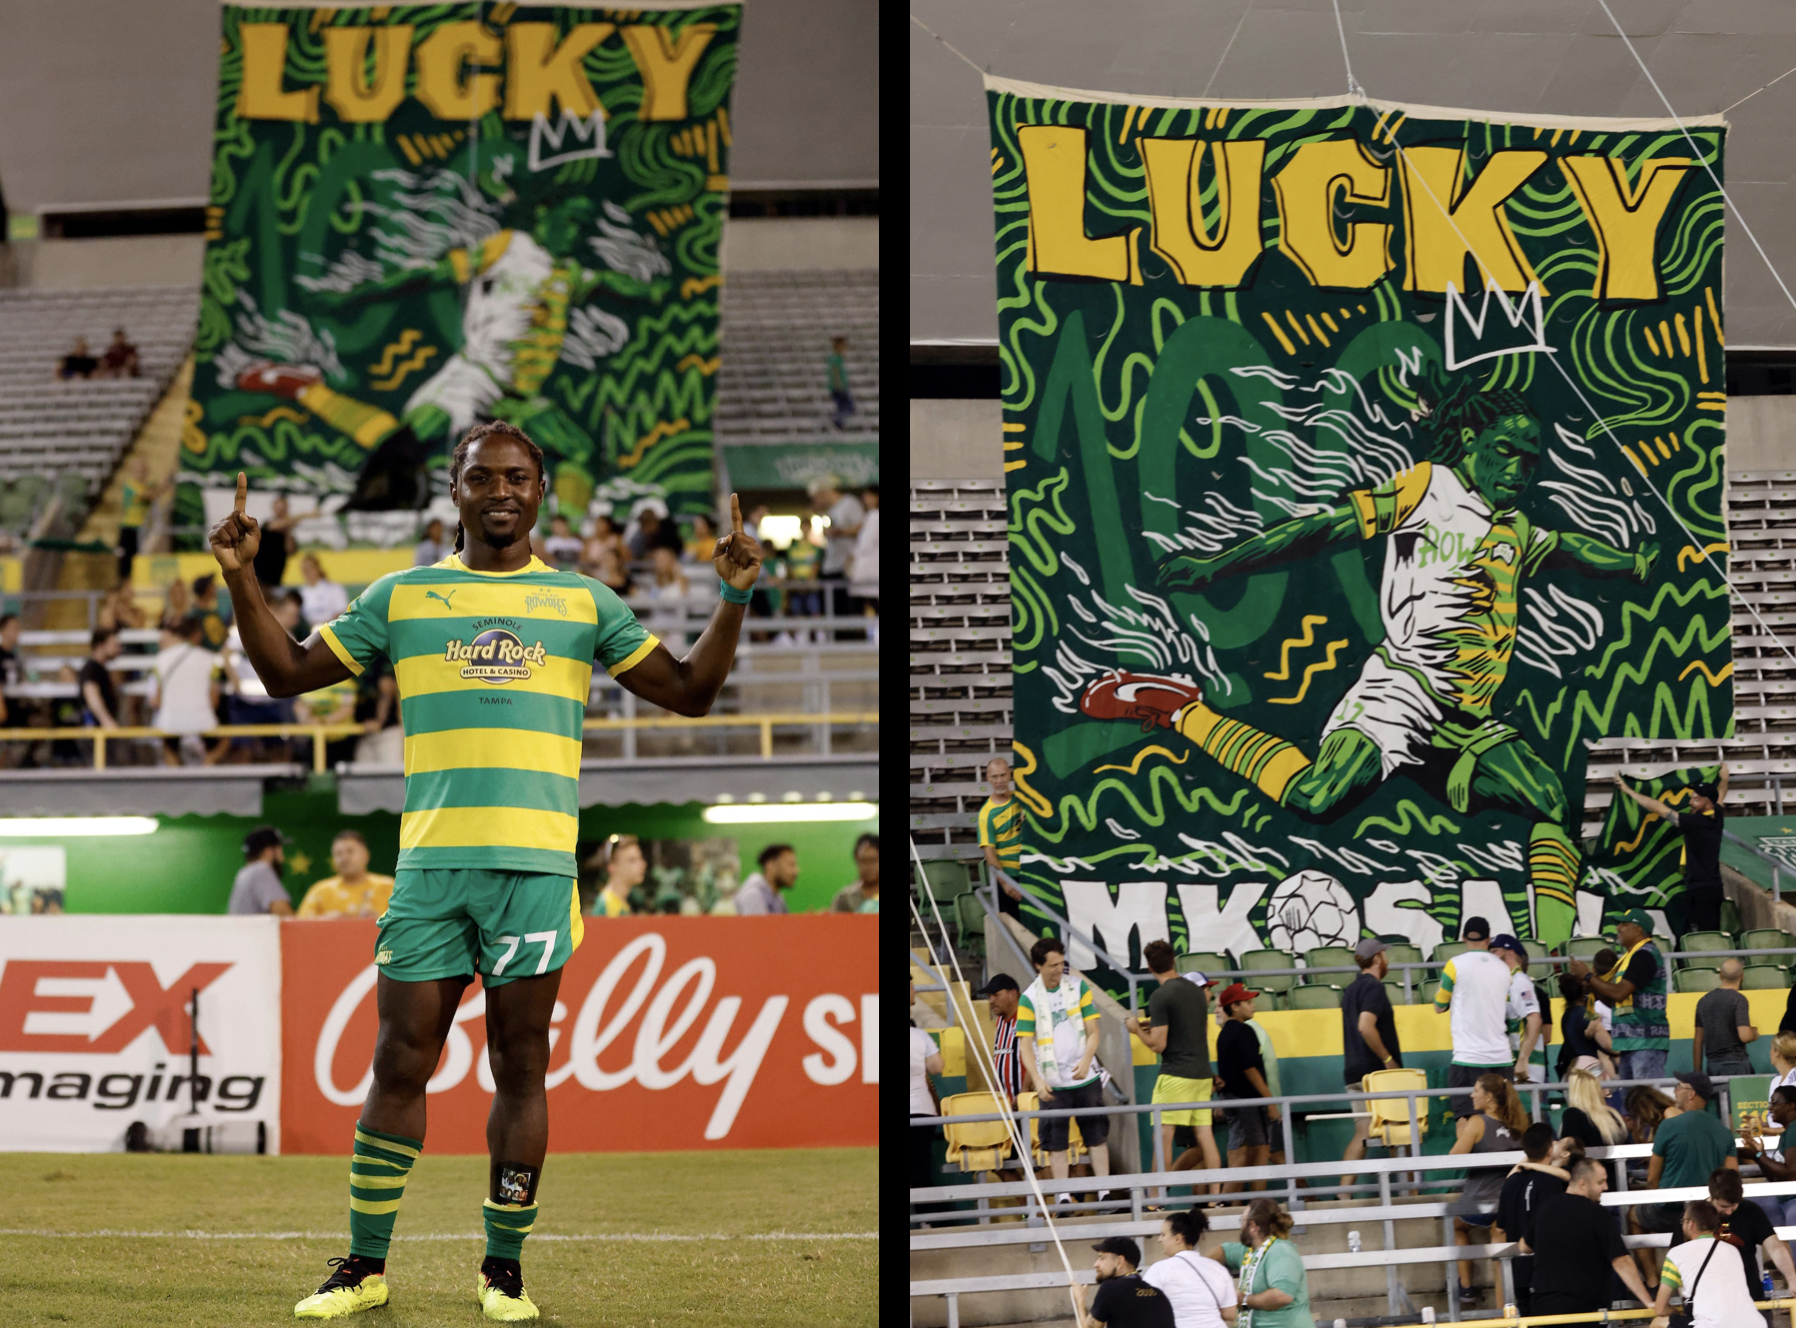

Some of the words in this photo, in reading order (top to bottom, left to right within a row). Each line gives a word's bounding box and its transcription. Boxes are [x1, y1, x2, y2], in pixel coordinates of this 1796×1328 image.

[235, 22, 719, 123] LUCKY
[1016, 122, 1692, 308] LUCKY
[472, 617, 523, 632] SEMINOLE
[445, 639, 498, 662] Hard
[498, 638, 547, 667] Rock
[463, 668, 488, 676] HOTEL
[498, 668, 528, 677] CASINO
[478, 697, 513, 705] TAMPA
[491, 929, 558, 977] 77
[314, 932, 789, 1140] Blly
[1737, 1100, 1769, 1110] SECTIO
